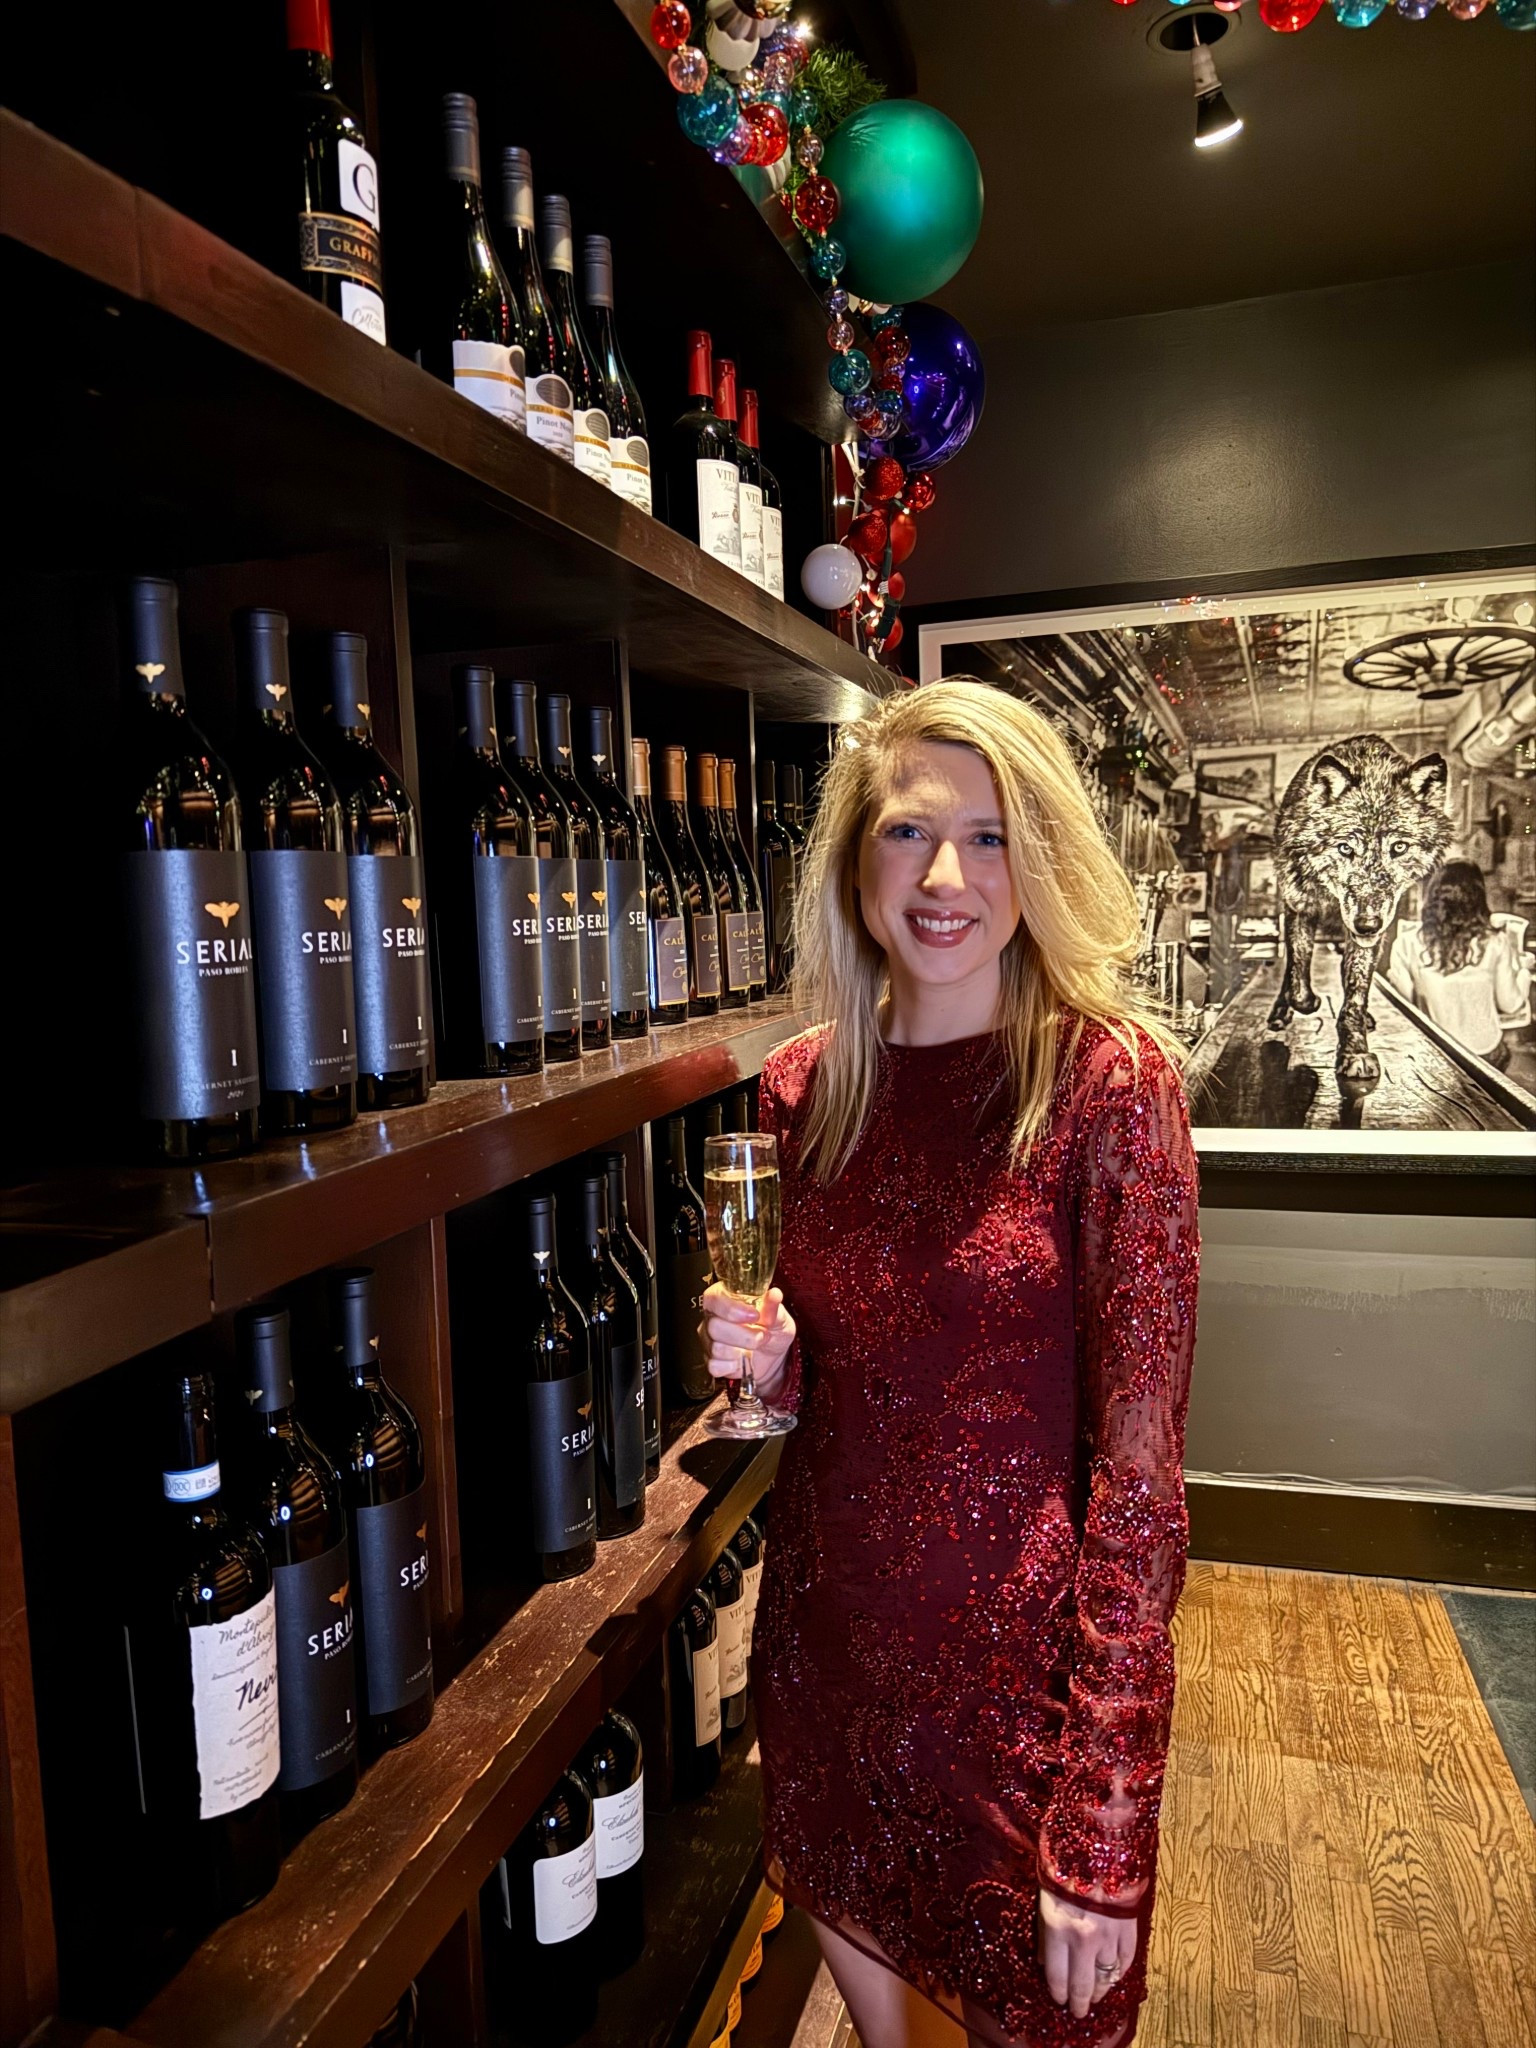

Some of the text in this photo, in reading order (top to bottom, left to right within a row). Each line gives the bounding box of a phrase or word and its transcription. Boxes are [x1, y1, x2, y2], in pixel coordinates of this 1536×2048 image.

[353, 163, 376, 214] G
[398, 950, 413, 958] PASO
[319, 956, 337, 965] PASO
[198, 967, 223, 977] PASO
[309, 1054, 344, 1067] CABERNET
